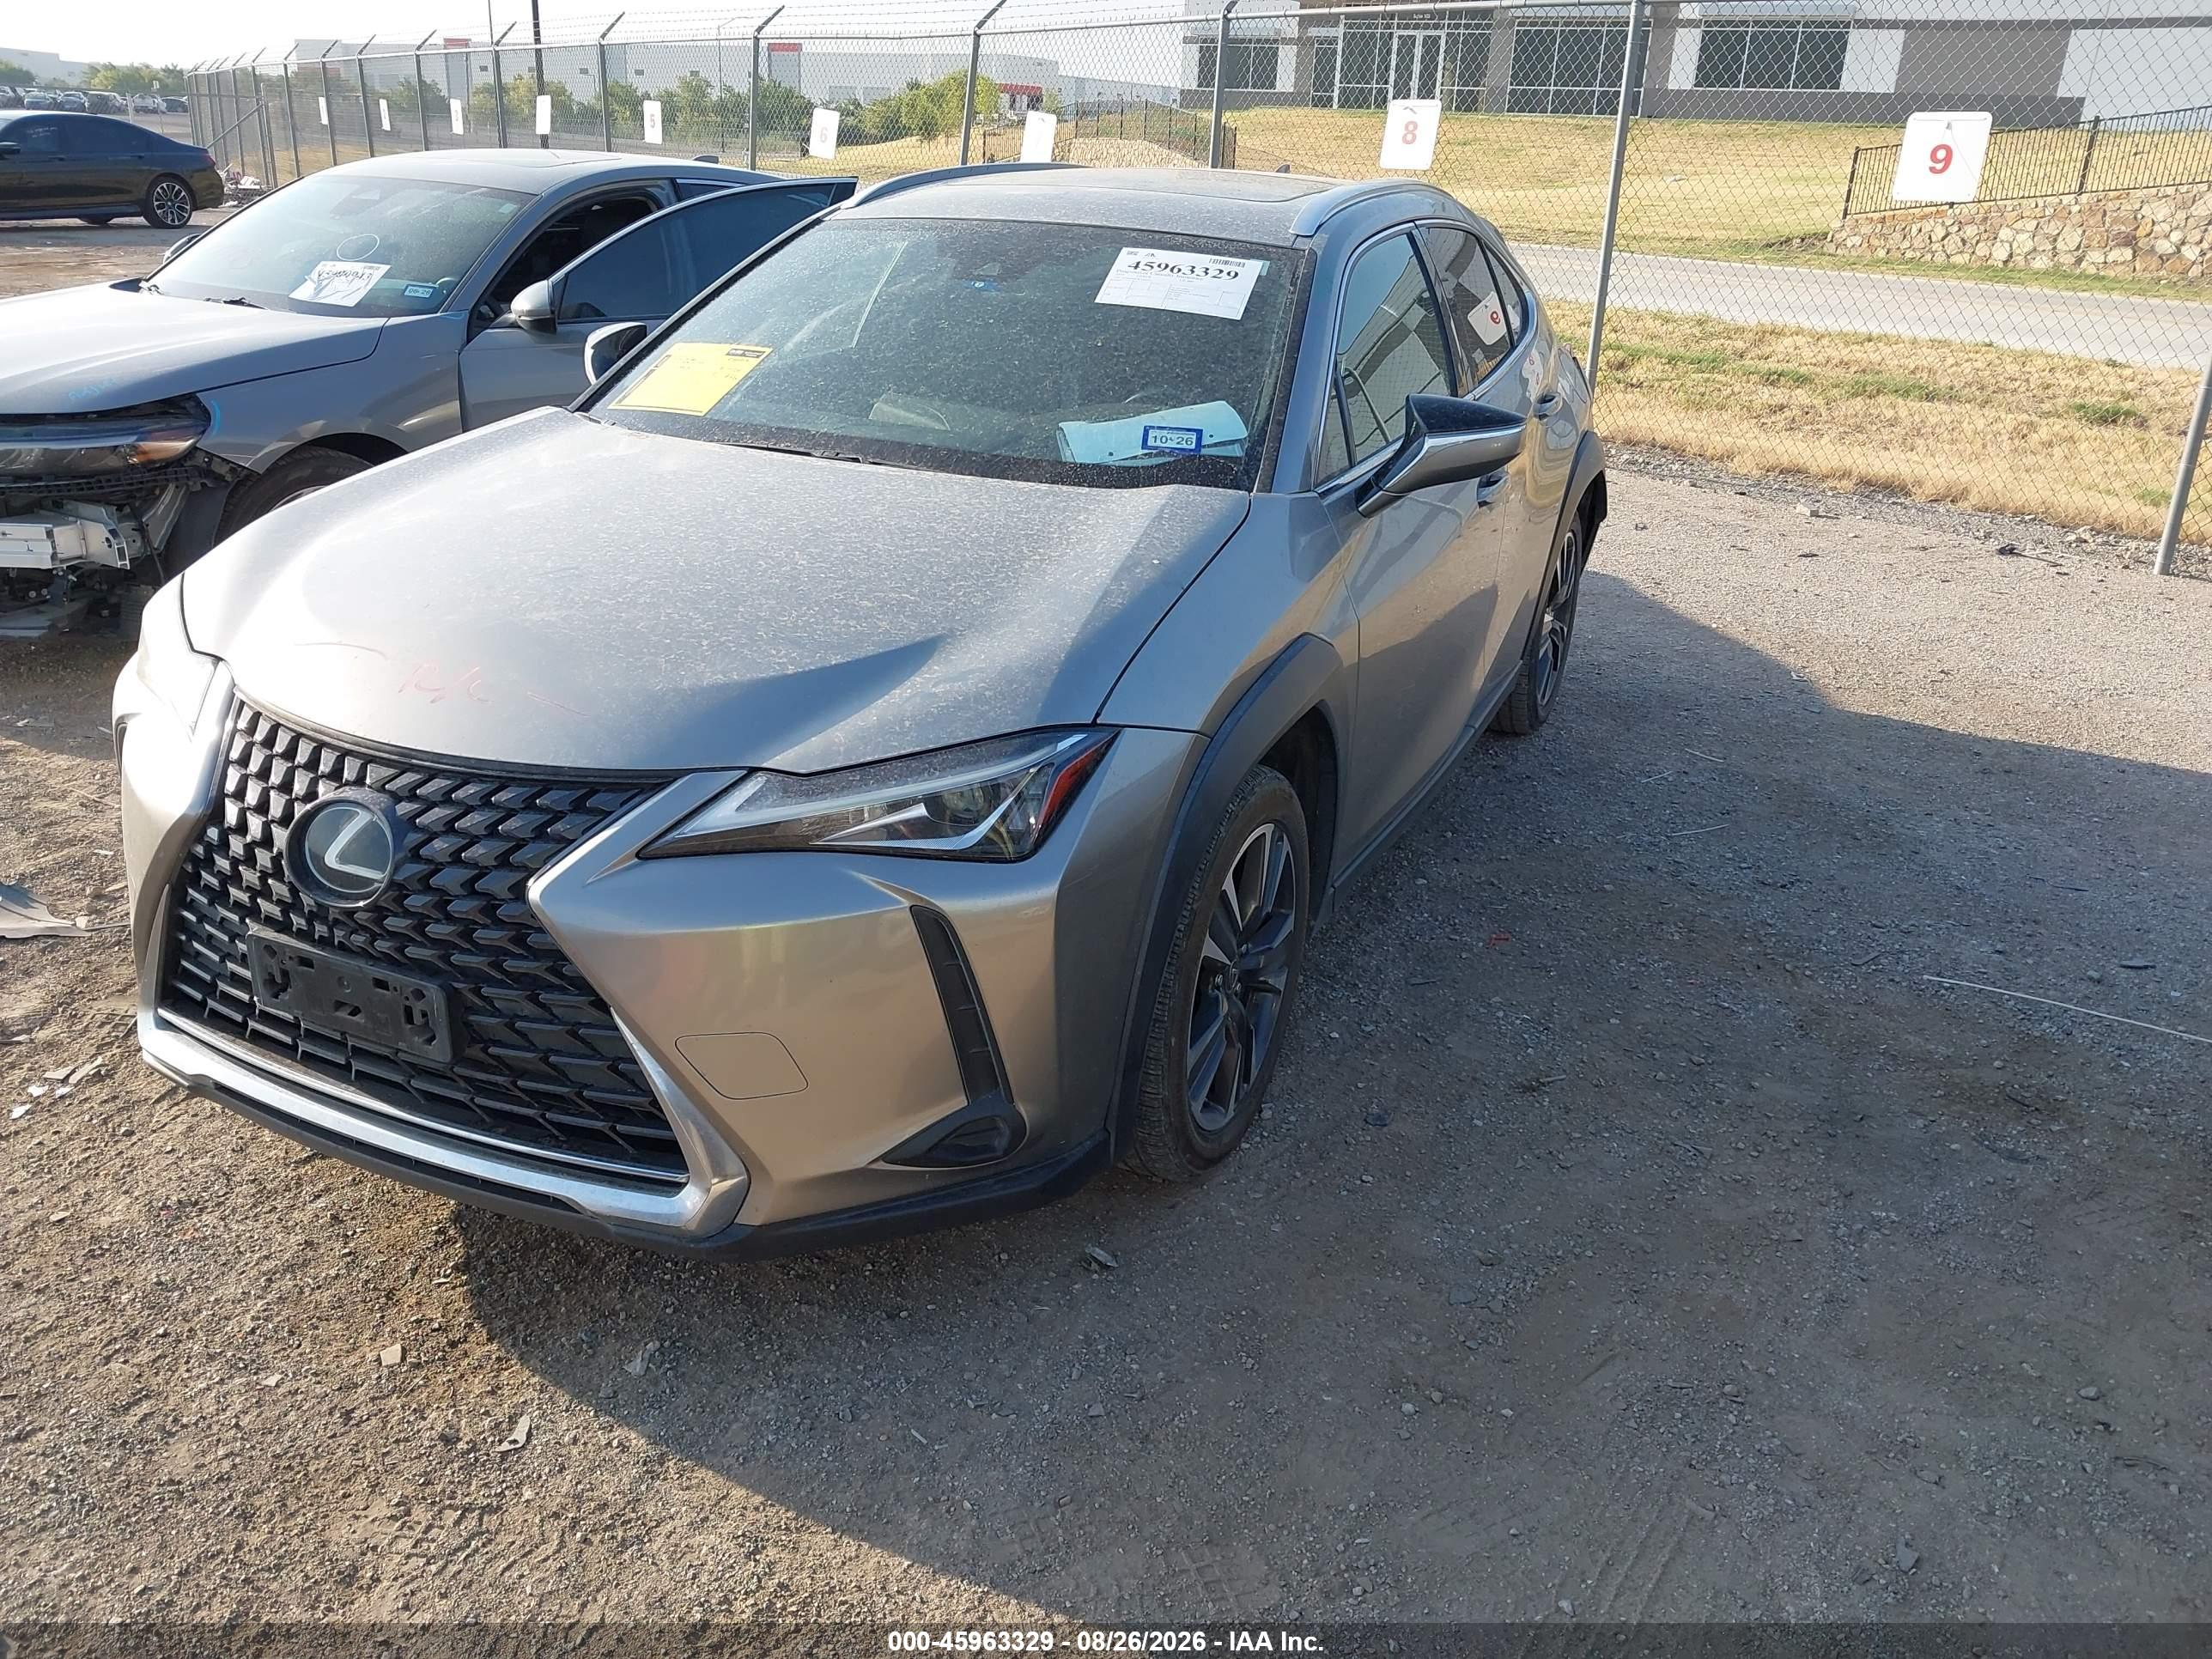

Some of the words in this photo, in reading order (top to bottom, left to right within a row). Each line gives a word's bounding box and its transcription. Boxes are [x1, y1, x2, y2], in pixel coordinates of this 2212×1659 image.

[650, 113, 655, 129] 5
[1401, 120, 1418, 144] 8
[820, 126, 829, 143] 6
[1929, 143, 1953, 174] 9
[1127, 259, 1239, 281] 45963329
